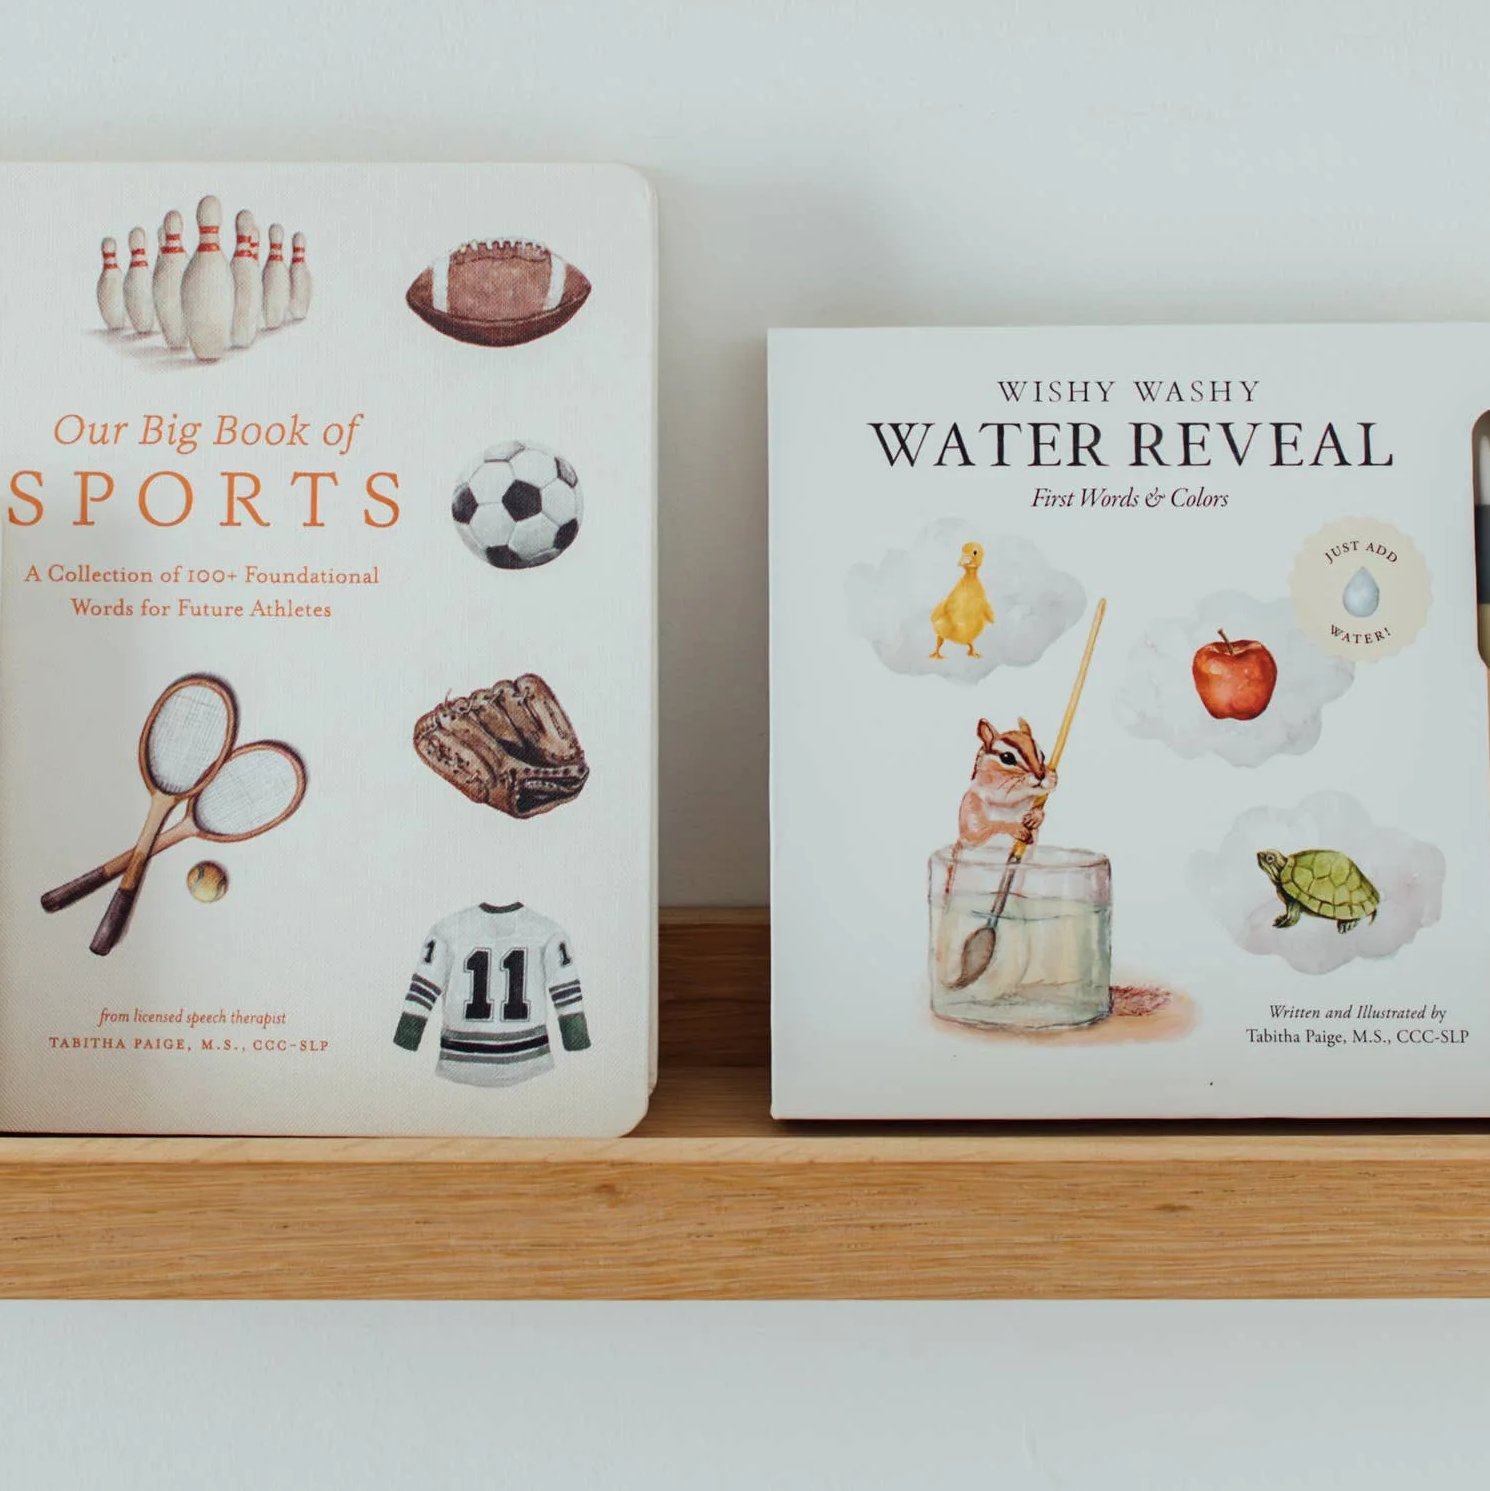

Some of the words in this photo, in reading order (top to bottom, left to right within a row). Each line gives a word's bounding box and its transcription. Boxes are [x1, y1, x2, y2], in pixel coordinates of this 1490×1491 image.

[997, 379, 1116, 403] WISHY
[1133, 379, 1260, 403] WASHY
[53, 413, 129, 446] Our
[138, 412, 203, 455] Big
[212, 413, 311, 447] Book
[322, 413, 364, 455] of
[866, 421, 1110, 468] WATER
[1127, 421, 1394, 468] REVEAL
[7, 469, 401, 529] SPORTS
[1030, 486, 1074, 509] First
[1079, 486, 1140, 509] Words
[1144, 489, 1166, 509] &
[1170, 486, 1229, 509] Colors
[1324, 540, 1359, 564] JUST
[1365, 542, 1398, 563] ADD
[24, 564, 42, 583] A
[47, 563, 154, 584] Collection
[159, 564, 184, 584] of
[187, 568, 238, 584] 100+
[244, 565, 380, 585] Foundational
[70, 597, 134, 617] Words
[140, 597, 171, 617] for
[177, 598, 245, 617] Future
[249, 598, 333, 618] Athletes
[1330, 624, 1391, 644] WATER!
[424, 939, 436, 964] 1
[559, 941, 572, 966] 1
[463, 947, 531, 1022] 11
[97, 1007, 130, 1027] from
[133, 1008, 183, 1024] licensed
[186, 1009, 227, 1029] speech
[230, 1010, 287, 1029] therapist
[1269, 1004, 1320, 1019] Written
[1325, 1004, 1352, 1019] and
[1356, 1004, 1425, 1020] Illustrated
[1430, 1004, 1447, 1023] by
[49, 1036, 126, 1050] TABITHA
[134, 1038, 192, 1052] PAIGE,
[201, 1038, 246, 1052] M.S.,
[252, 1040, 329, 1052] CCC-SLP
[1245, 1028, 1300, 1044] Tabitha
[1305, 1029, 1347, 1048] Paige,
[1352, 1029, 1391, 1045] M.S.,
[1396, 1029, 1470, 1044] CCC-SLP
